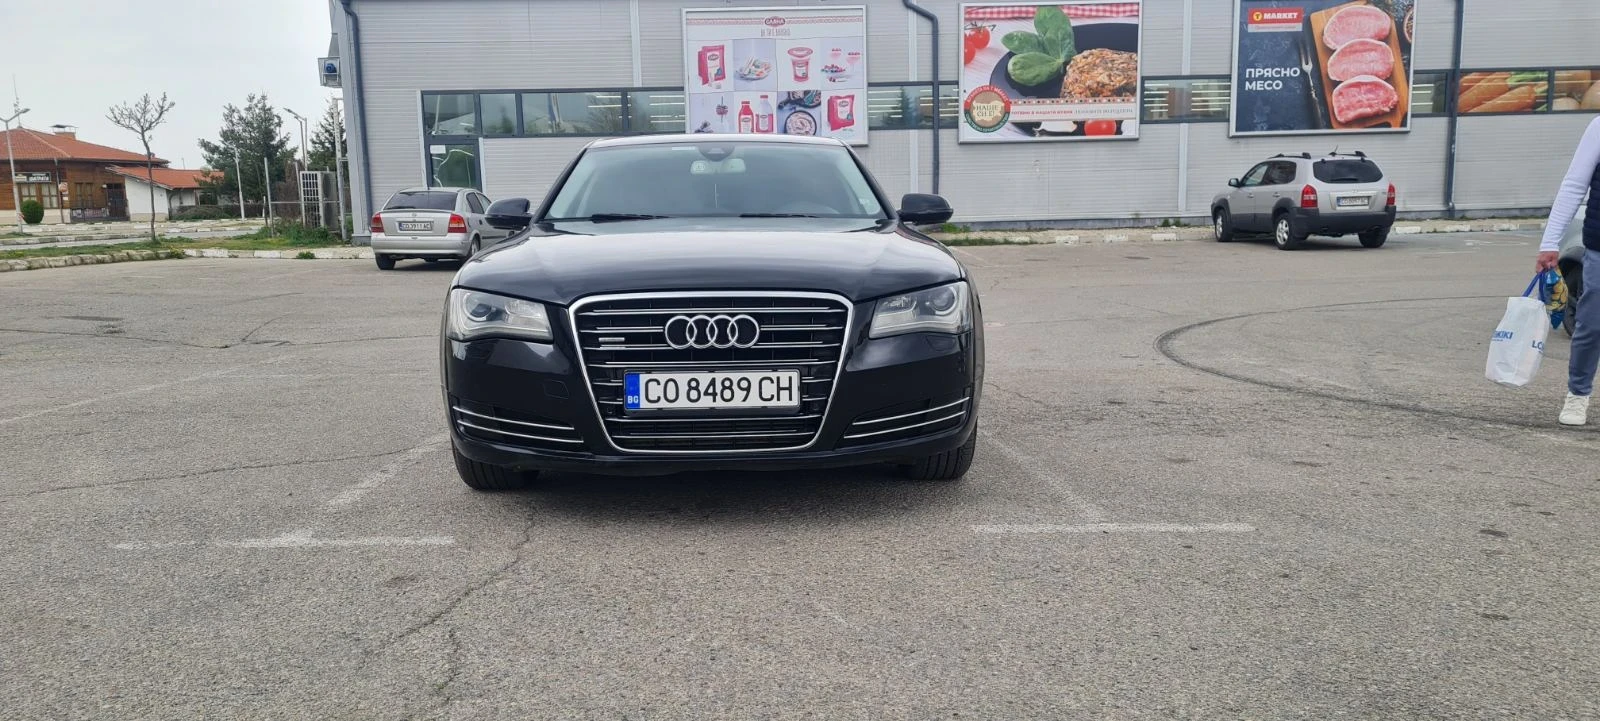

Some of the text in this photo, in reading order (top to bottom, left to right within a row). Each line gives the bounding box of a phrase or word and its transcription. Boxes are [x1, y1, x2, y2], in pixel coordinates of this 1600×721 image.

[1245, 67, 1300, 78] ПРЯСНО
[1245, 80, 1283, 91] МЕСО
[645, 376, 793, 403] CO 8489 CH
[627, 395, 639, 404] BG
